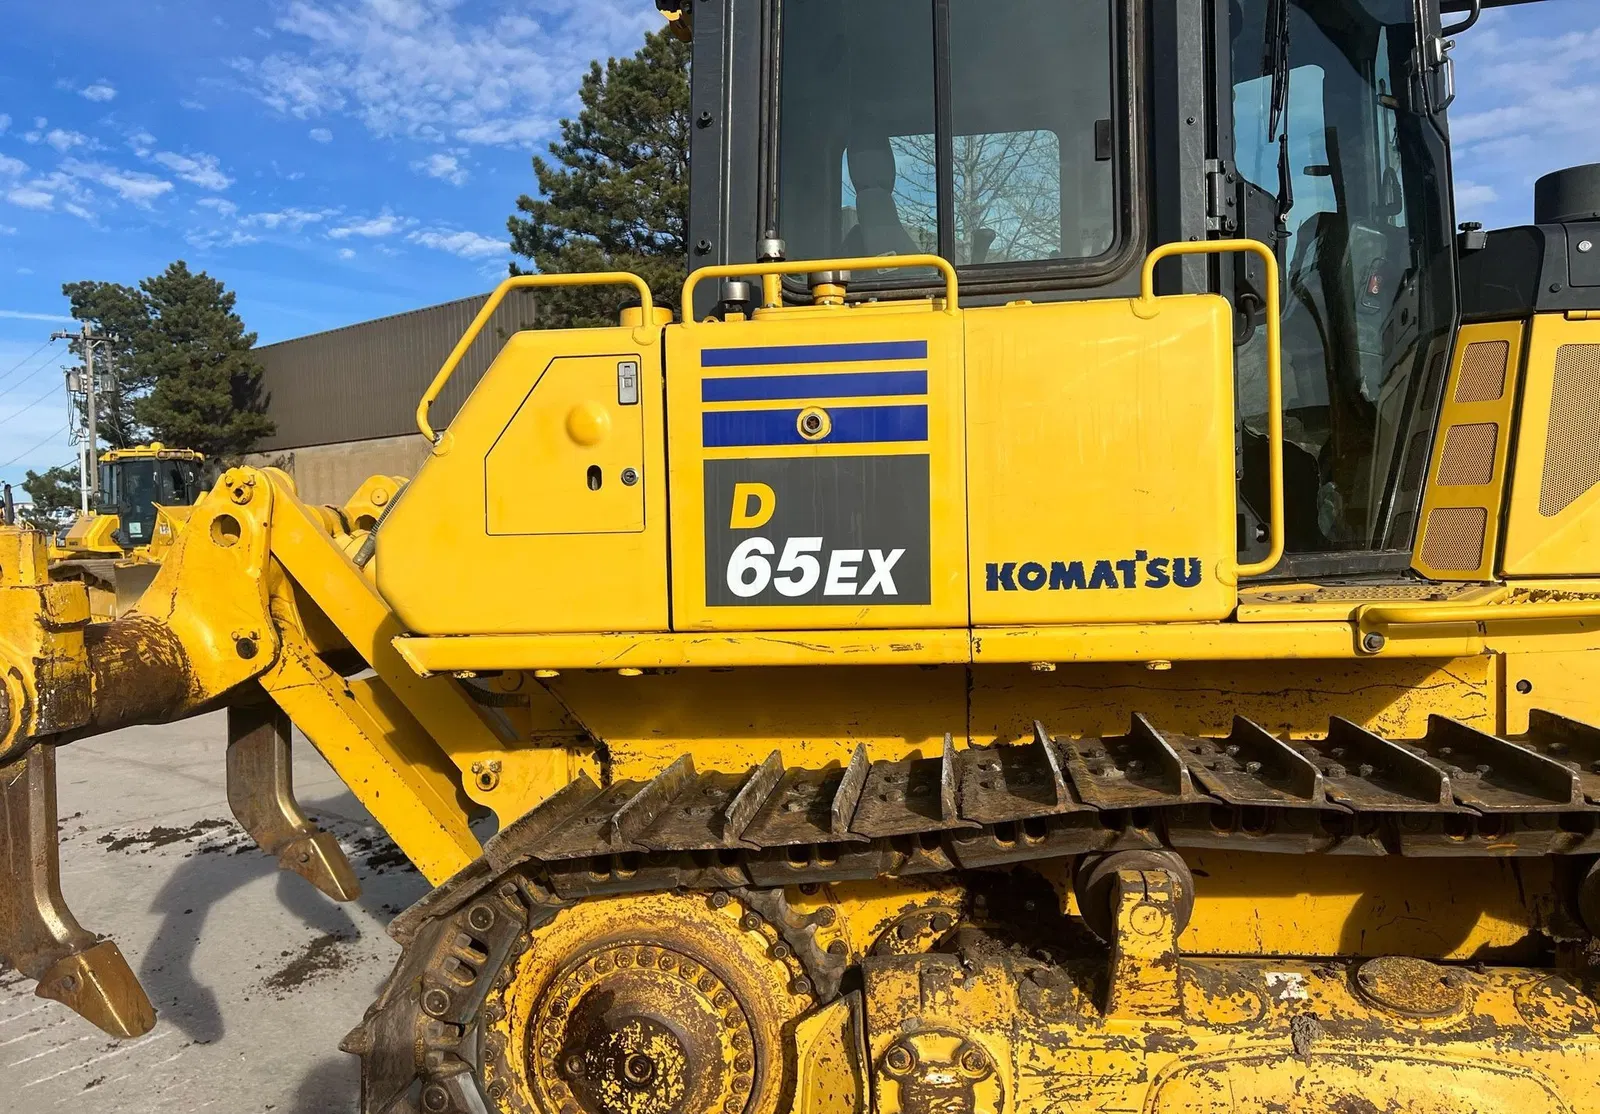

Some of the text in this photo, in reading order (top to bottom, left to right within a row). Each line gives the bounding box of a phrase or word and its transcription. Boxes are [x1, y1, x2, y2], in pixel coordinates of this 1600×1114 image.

[730, 482, 776, 529] D
[726, 536, 906, 598] 65EX
[985, 550, 1202, 591] KOMATSU
